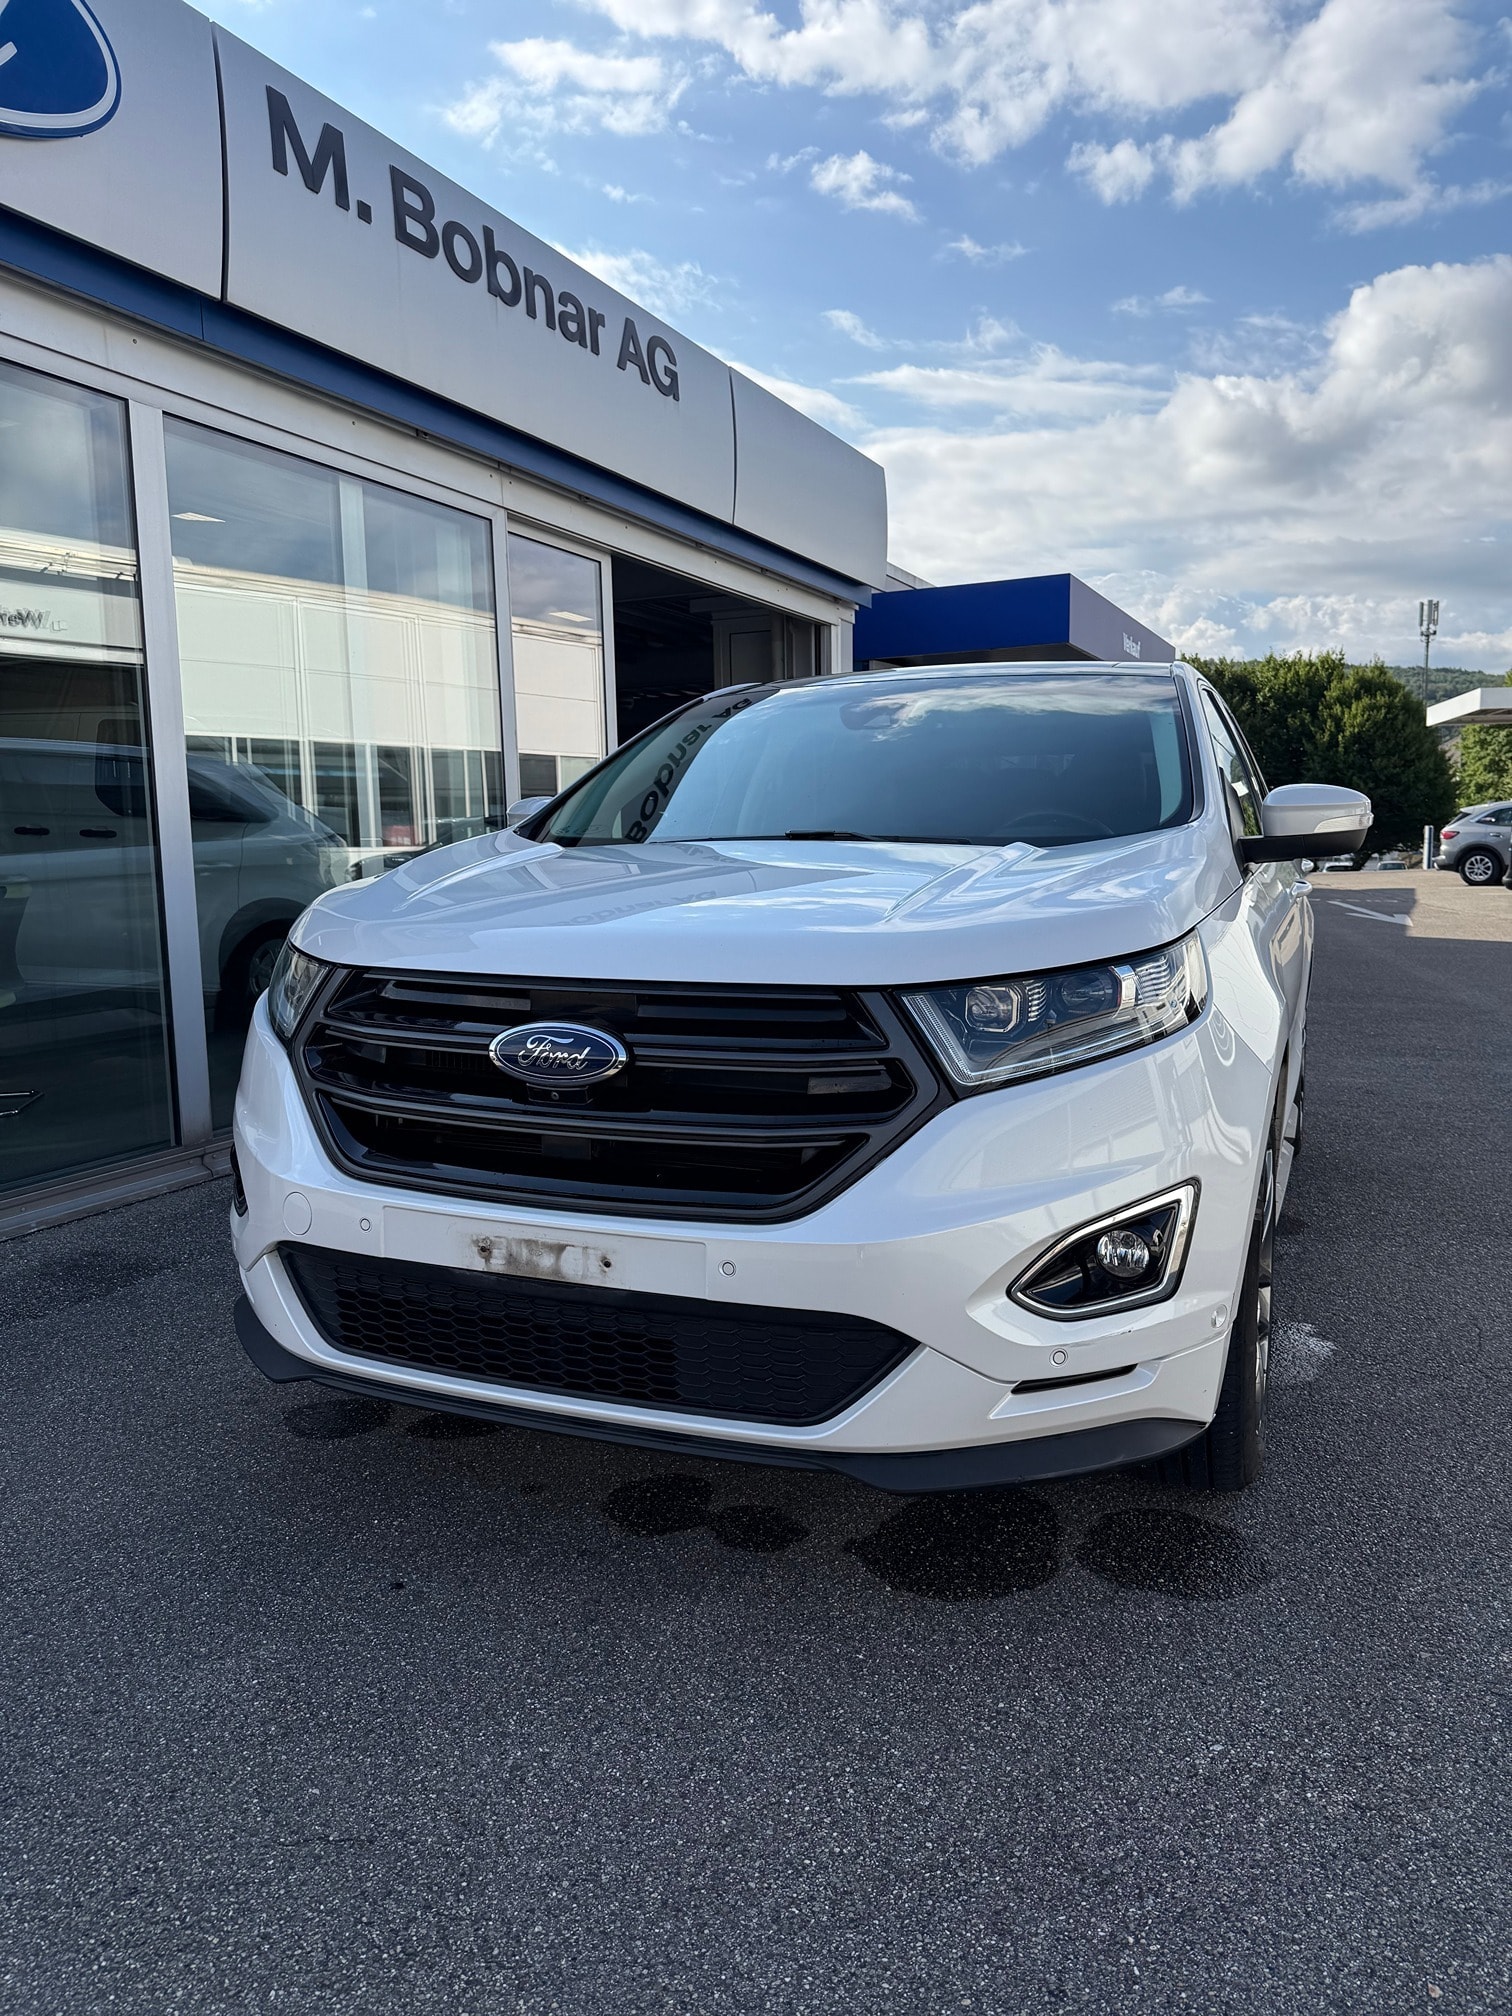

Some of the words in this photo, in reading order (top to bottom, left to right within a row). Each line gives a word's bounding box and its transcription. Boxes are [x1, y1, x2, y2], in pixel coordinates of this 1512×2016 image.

[266, 84, 372, 224] M.
[389, 164, 605, 356] Bobnar
[617, 317, 680, 401] AG
[517, 1034, 592, 1071] Ford
